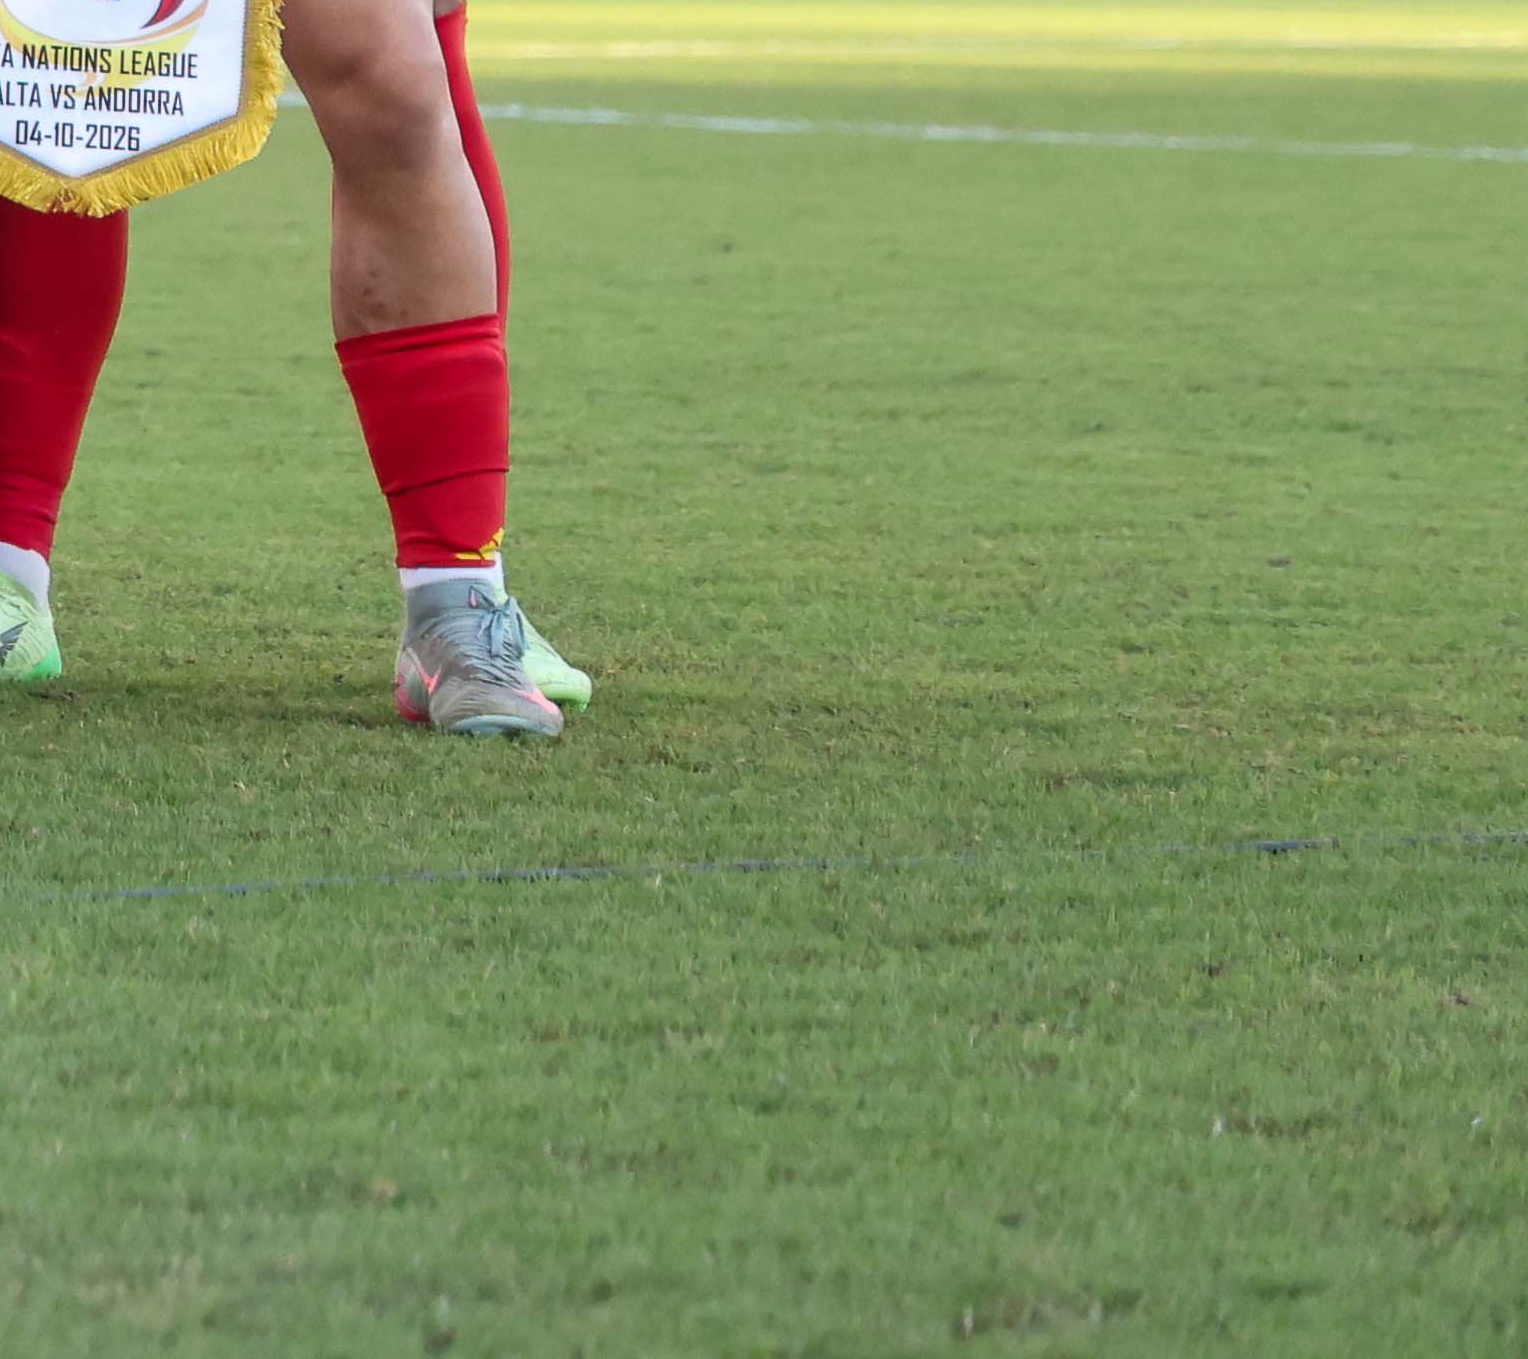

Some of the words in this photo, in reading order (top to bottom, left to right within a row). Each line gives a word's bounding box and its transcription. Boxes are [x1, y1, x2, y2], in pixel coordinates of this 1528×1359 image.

[21, 43, 112, 75] NATIONS
[119, 48, 199, 79] LEAGUE
[49, 83, 77, 110] VS
[84, 85, 185, 116] ANDORRA
[14, 119, 141, 152] 04-10-2026
